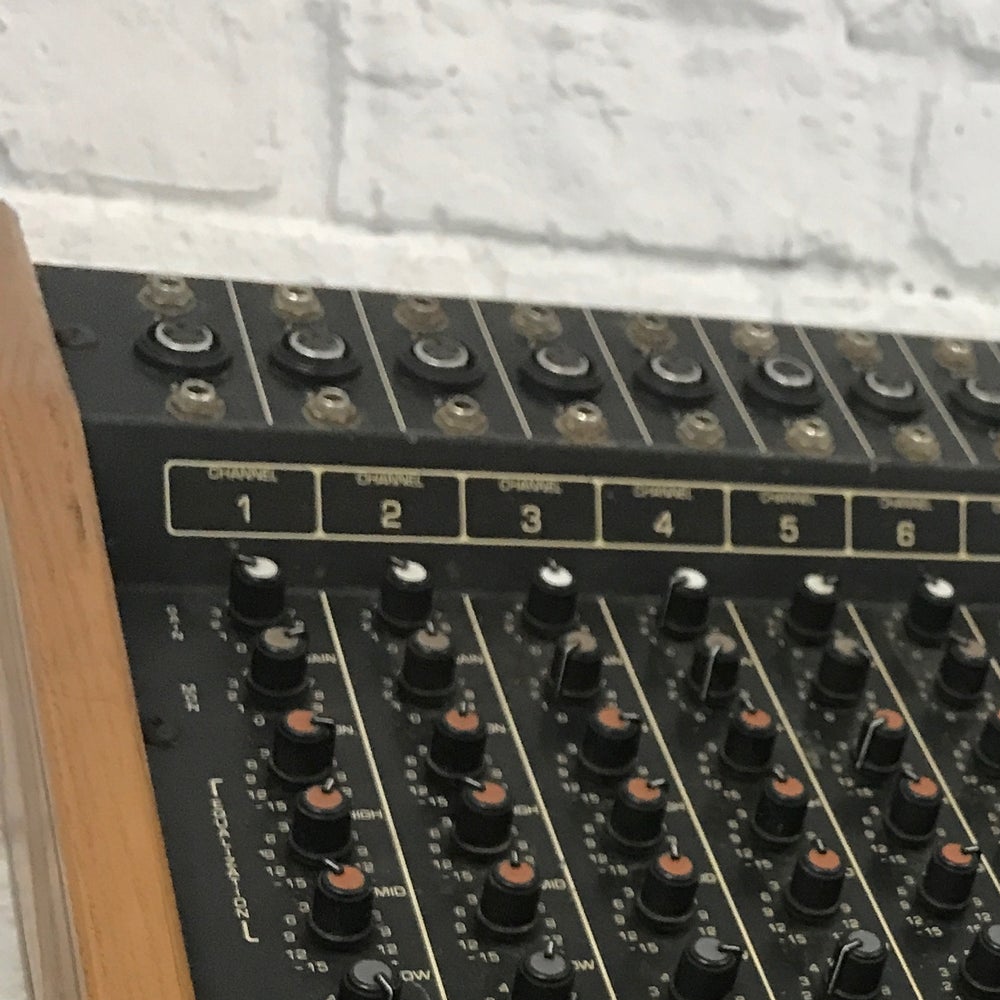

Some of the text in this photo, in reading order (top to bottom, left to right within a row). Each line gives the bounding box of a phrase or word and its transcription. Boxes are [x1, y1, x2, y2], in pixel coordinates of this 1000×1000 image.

[238, 495, 250, 523] 1
[380, 499, 401, 528] 2
[521, 504, 541, 533] 3
[654, 511, 674, 537] 4
[780, 515, 799, 543] 5
[896, 520, 915, 547] 6
[351, 807, 385, 820] IGH
[374, 884, 408, 897] MID
[401, 969, 430, 981] OW
